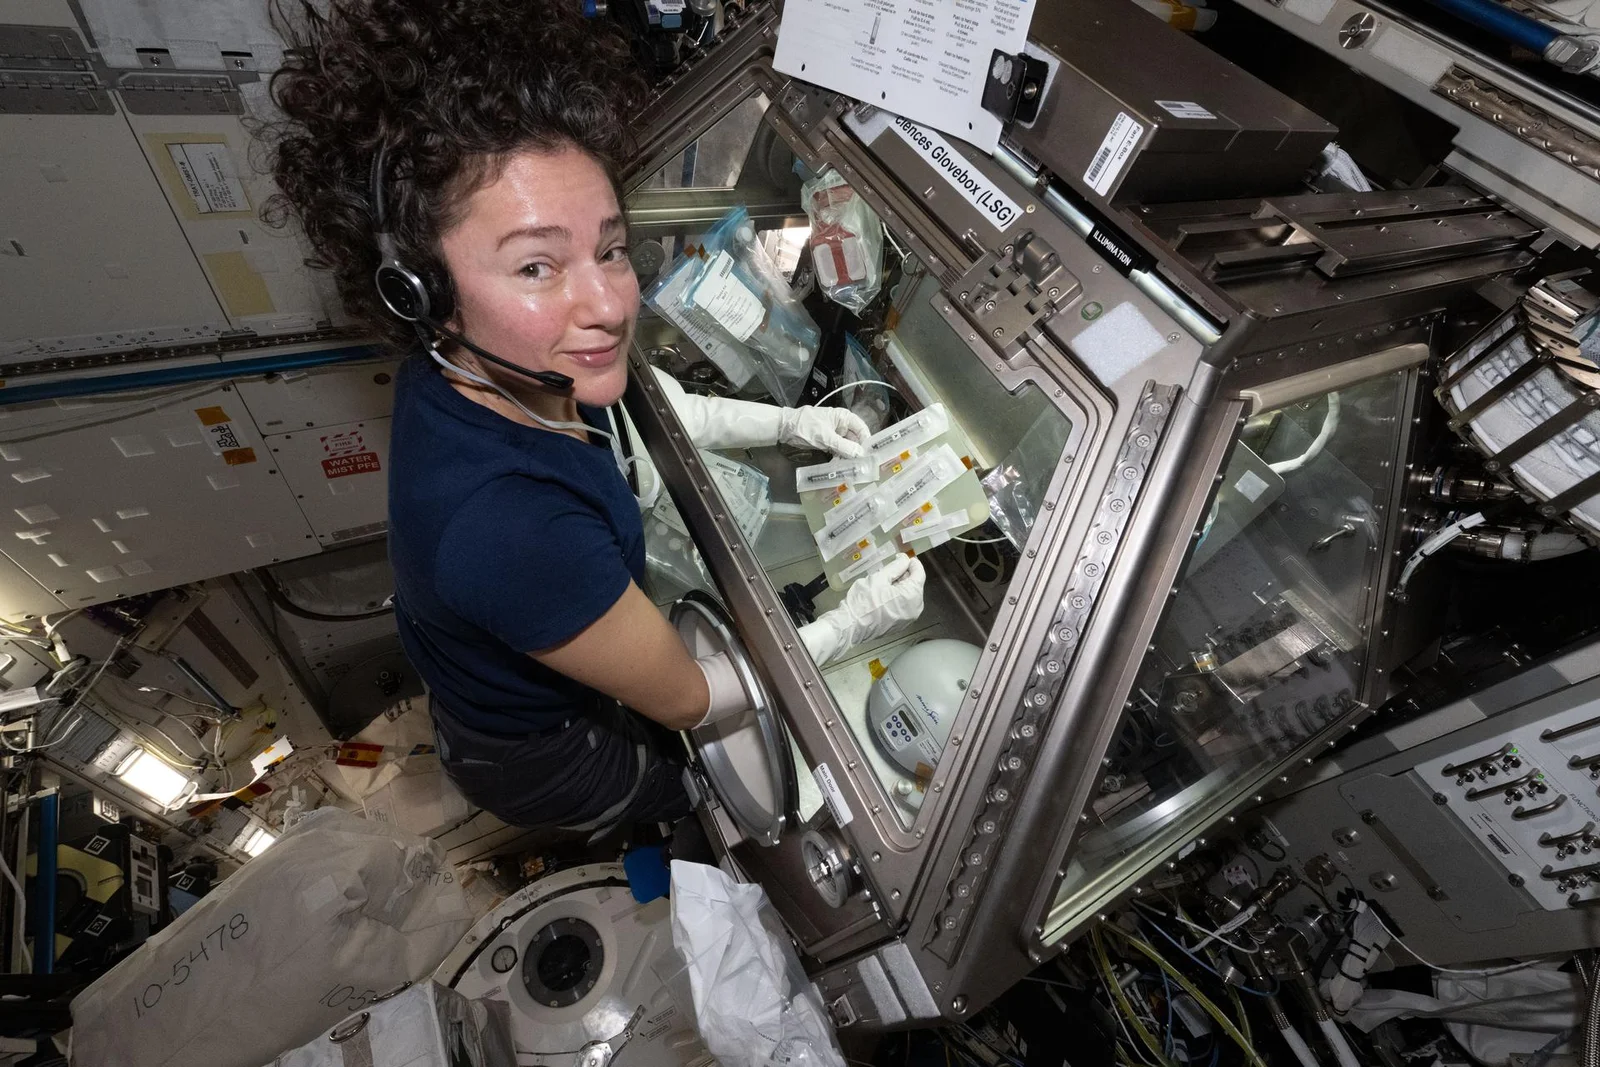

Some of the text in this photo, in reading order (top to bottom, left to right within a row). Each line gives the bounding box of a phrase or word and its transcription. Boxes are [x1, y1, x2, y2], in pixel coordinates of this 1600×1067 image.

[1118, 125, 1141, 160] Fan E-Box
[931, 146, 981, 196] Glovebox
[975, 190, 1016, 227] (LSG)
[1093, 230, 1132, 266] ILLUMINATION
[327, 461, 379, 475] MIST PFE
[329, 455, 371, 467] WATER
[820, 764, 836, 793] Main Door
[134, 913, 249, 1019] 10-5478
